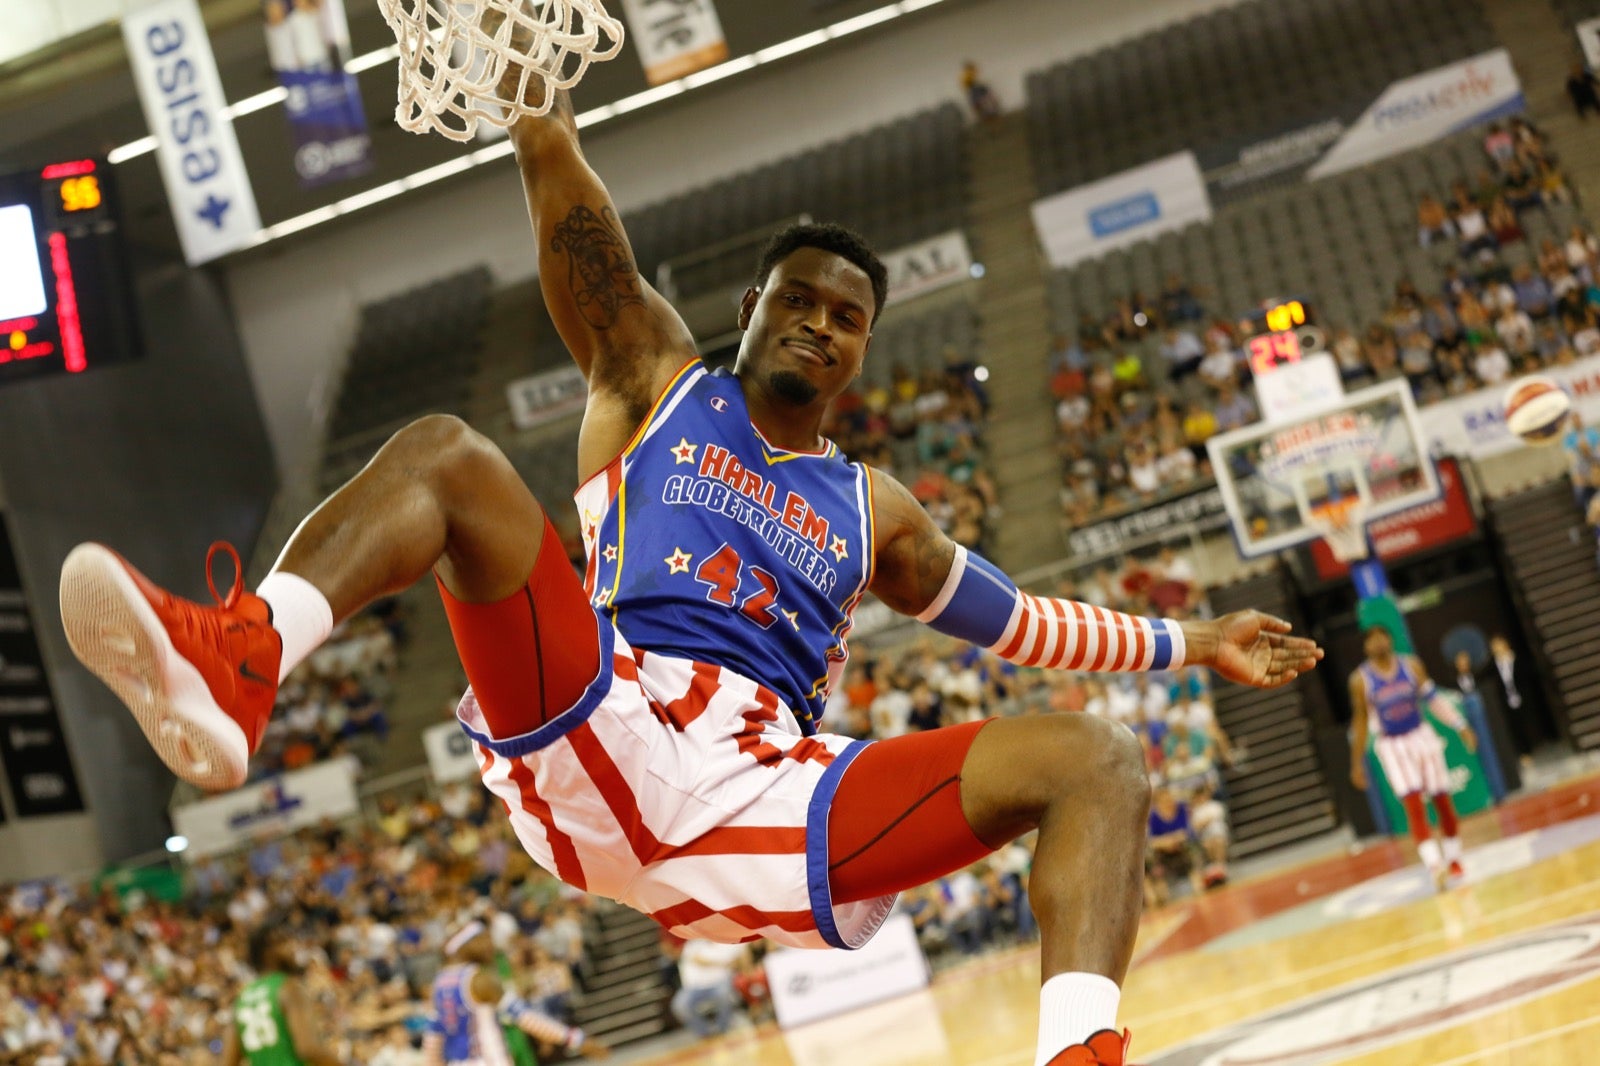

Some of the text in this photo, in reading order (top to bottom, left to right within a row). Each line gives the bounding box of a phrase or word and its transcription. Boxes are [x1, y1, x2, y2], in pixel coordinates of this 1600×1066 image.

[145, 20, 221, 184] asisa
[1250, 331, 1302, 377] 24
[662, 475, 837, 599] GLOBETROTTERS
[698, 443, 830, 553] HARLEM
[695, 541, 781, 630] 42
